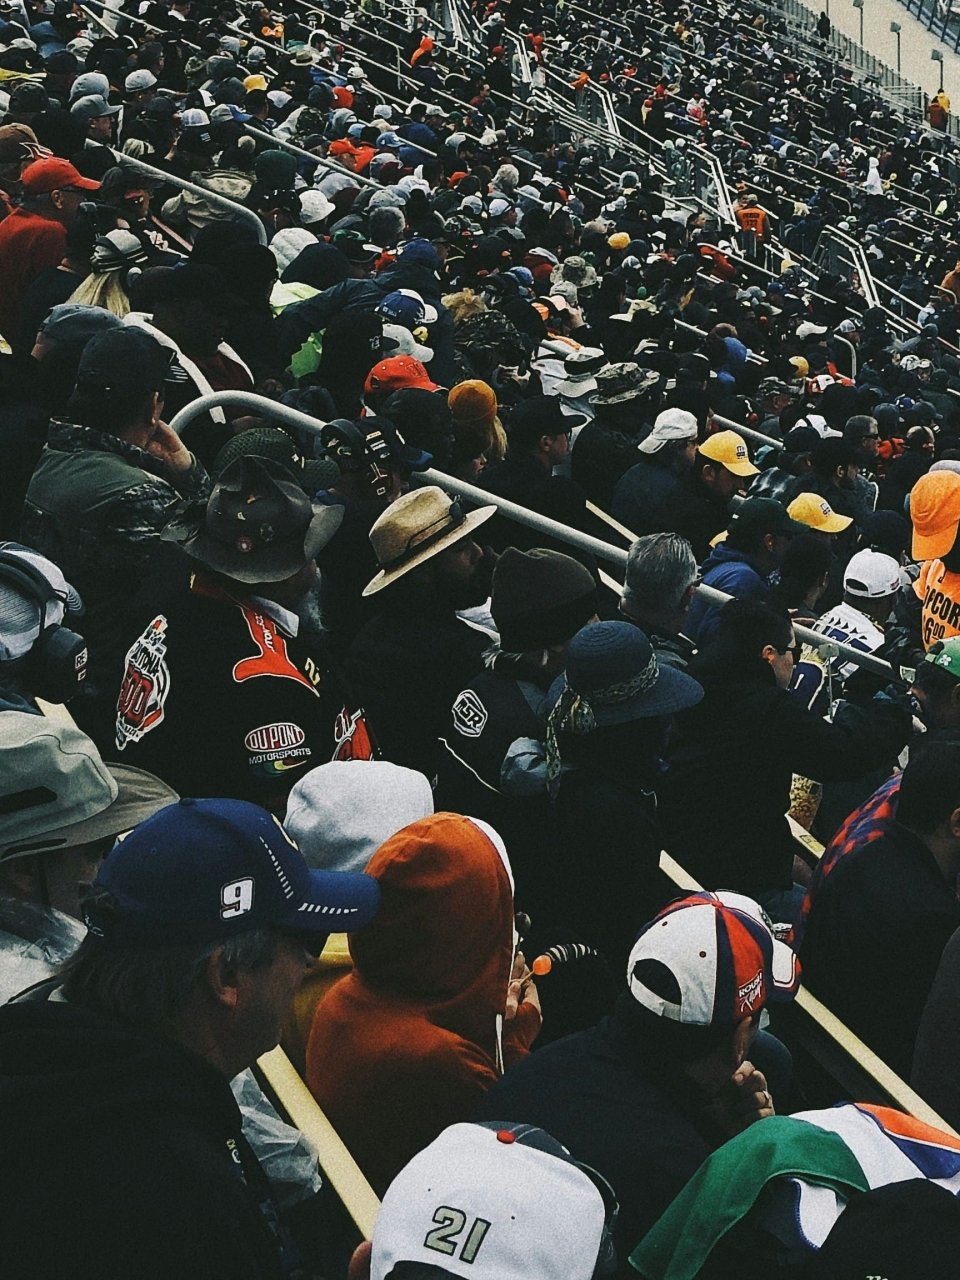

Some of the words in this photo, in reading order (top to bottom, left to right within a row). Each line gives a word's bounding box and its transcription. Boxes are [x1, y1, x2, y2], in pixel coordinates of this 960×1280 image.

[248, 747, 312, 765] MOTORSPORTS
[220, 876, 255, 921] 9
[423, 1205, 492, 1265] 21
